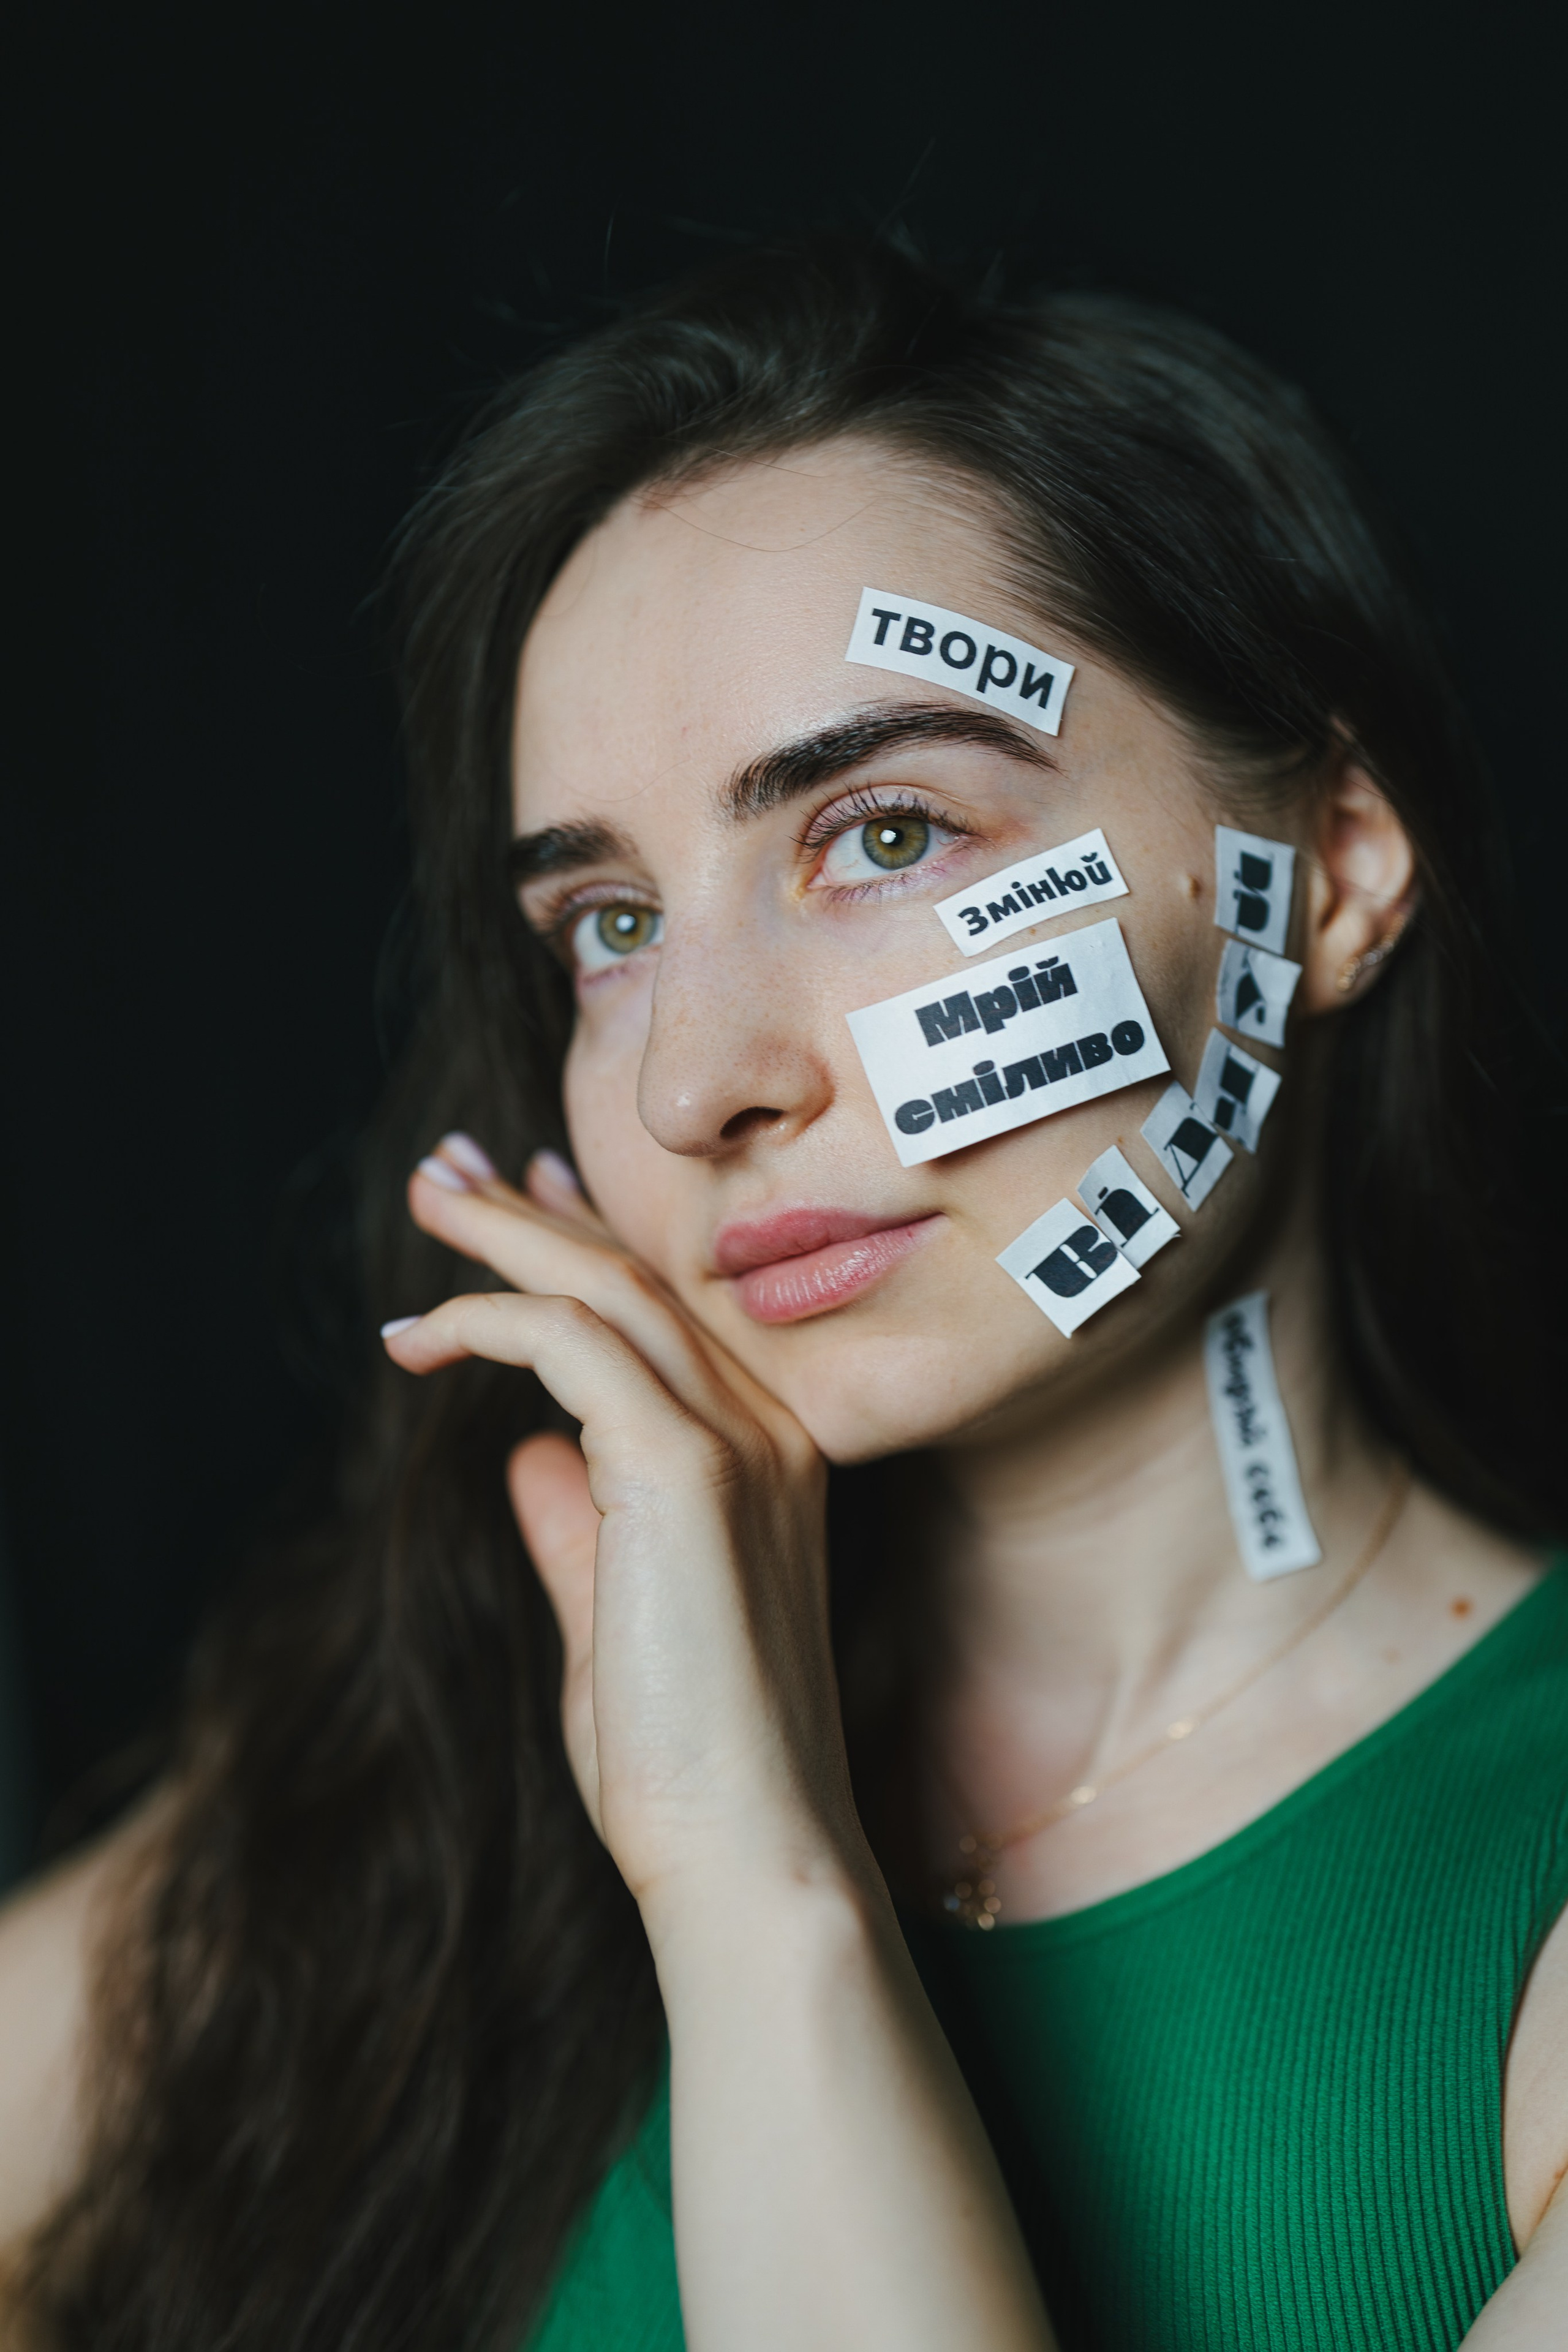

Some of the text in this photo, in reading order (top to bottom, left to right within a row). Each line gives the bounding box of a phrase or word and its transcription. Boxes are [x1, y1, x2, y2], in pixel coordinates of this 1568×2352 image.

[872, 608, 1055, 709] твори
[957, 851, 1114, 937] Змінюй
[914, 956, 1079, 1047] Мрій
[894, 1019, 1145, 1135] сміливо
